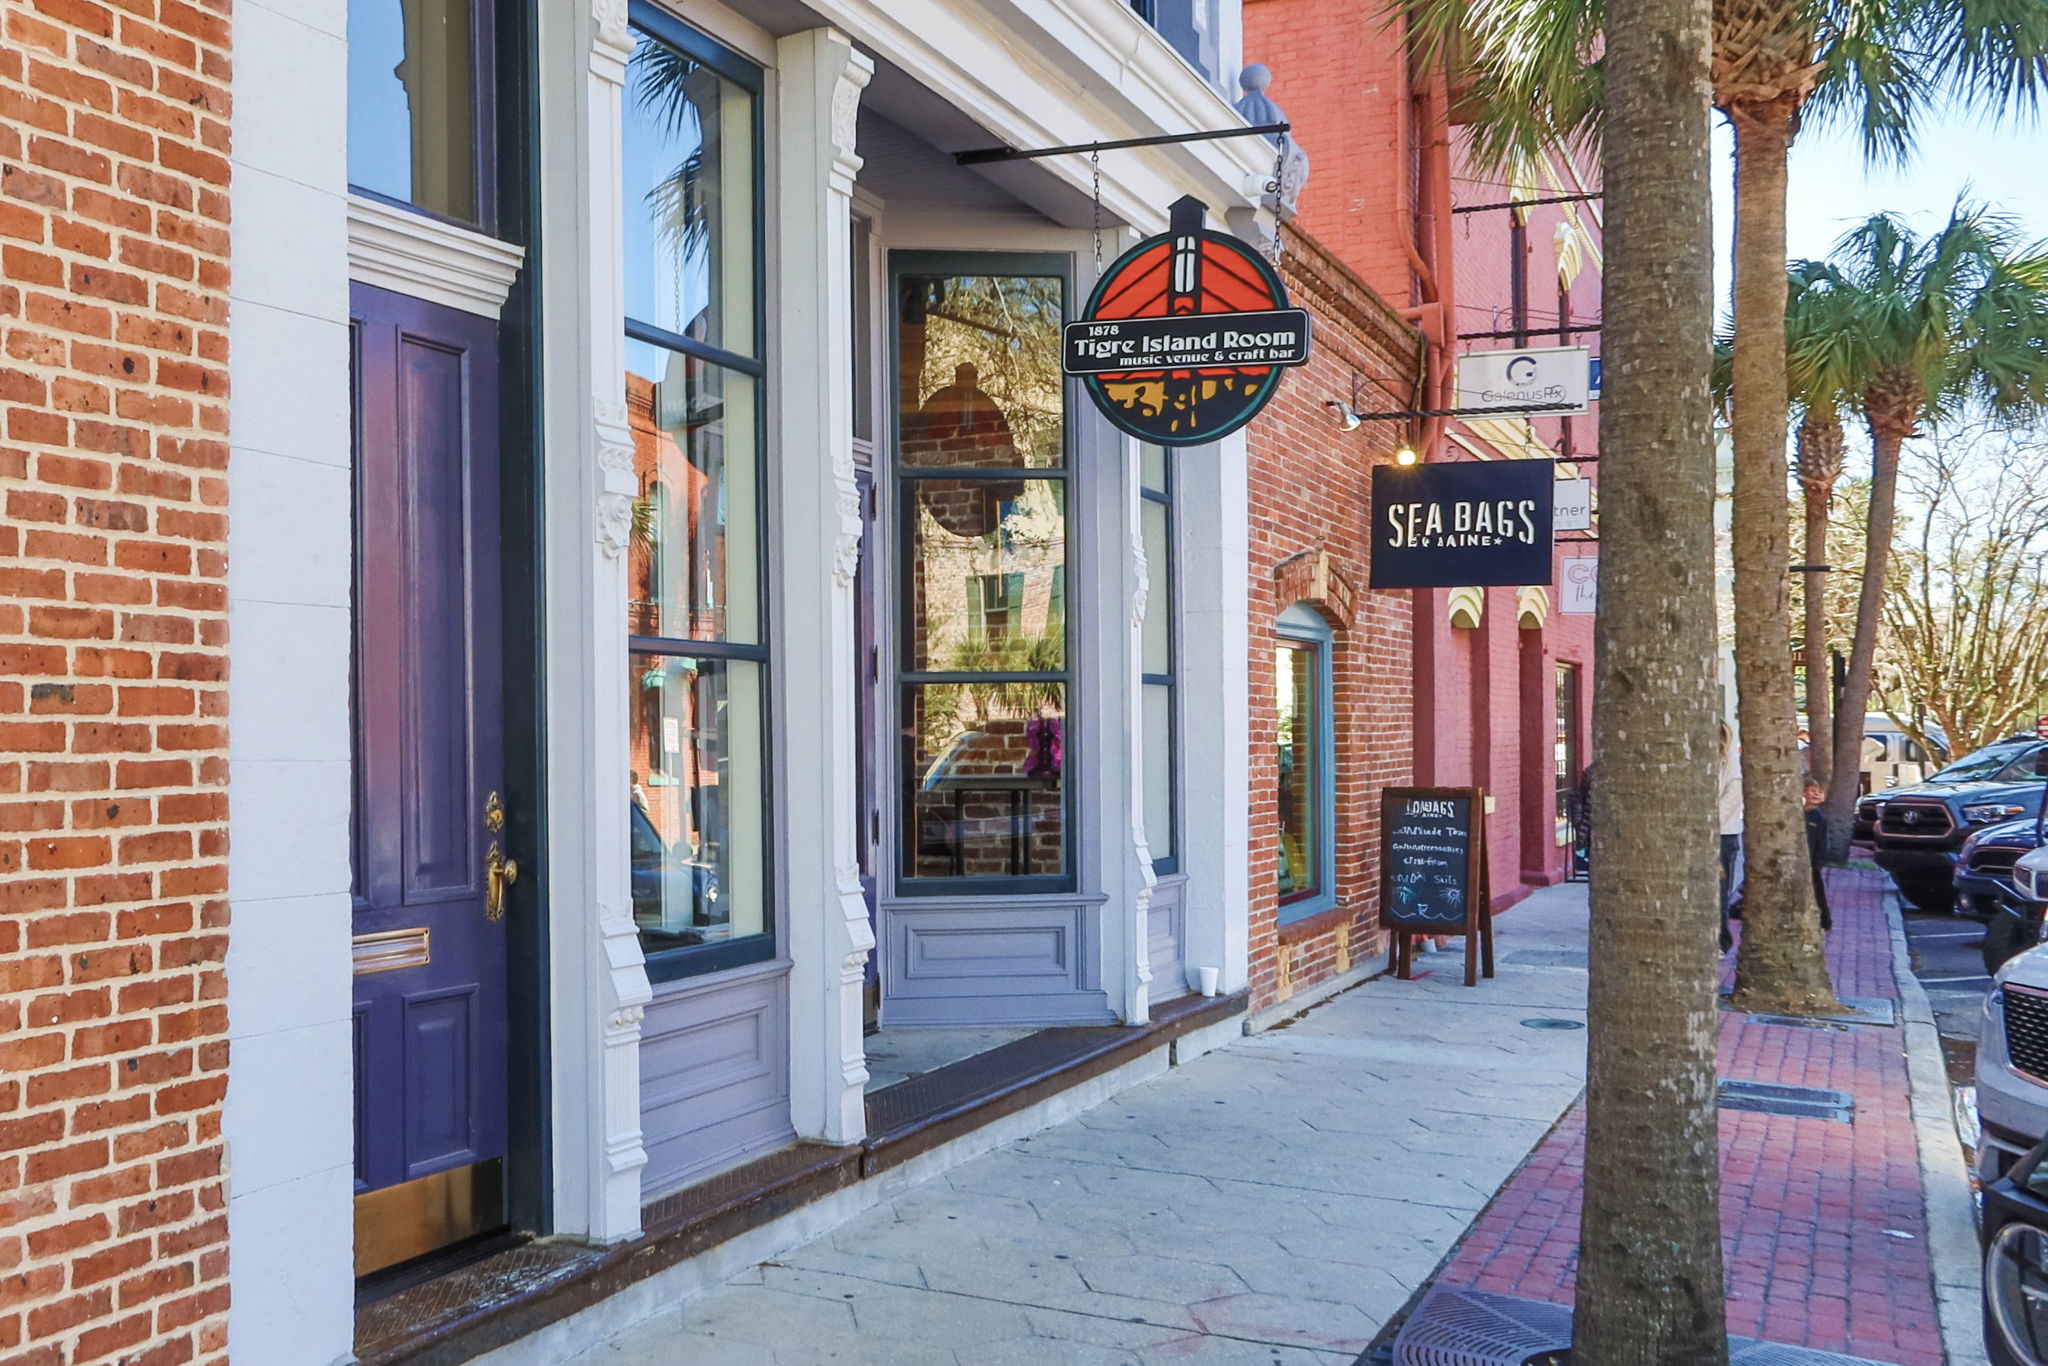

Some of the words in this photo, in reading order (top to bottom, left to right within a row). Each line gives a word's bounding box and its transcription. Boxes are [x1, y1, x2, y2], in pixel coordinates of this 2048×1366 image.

[1088, 325, 1120, 337] 1878
[1074, 338, 1136, 359] Tigre
[1142, 331, 1217, 353] Island
[1222, 330, 1296, 349] Room
[1119, 354, 1163, 367] music
[1166, 352, 1210, 364] venue
[1214, 350, 1225, 362] &
[1228, 349, 1266, 361] craft
[1268, 347, 1296, 360] bar
[1388, 502, 1443, 548] SEA
[1454, 499, 1536, 545] BAGS
